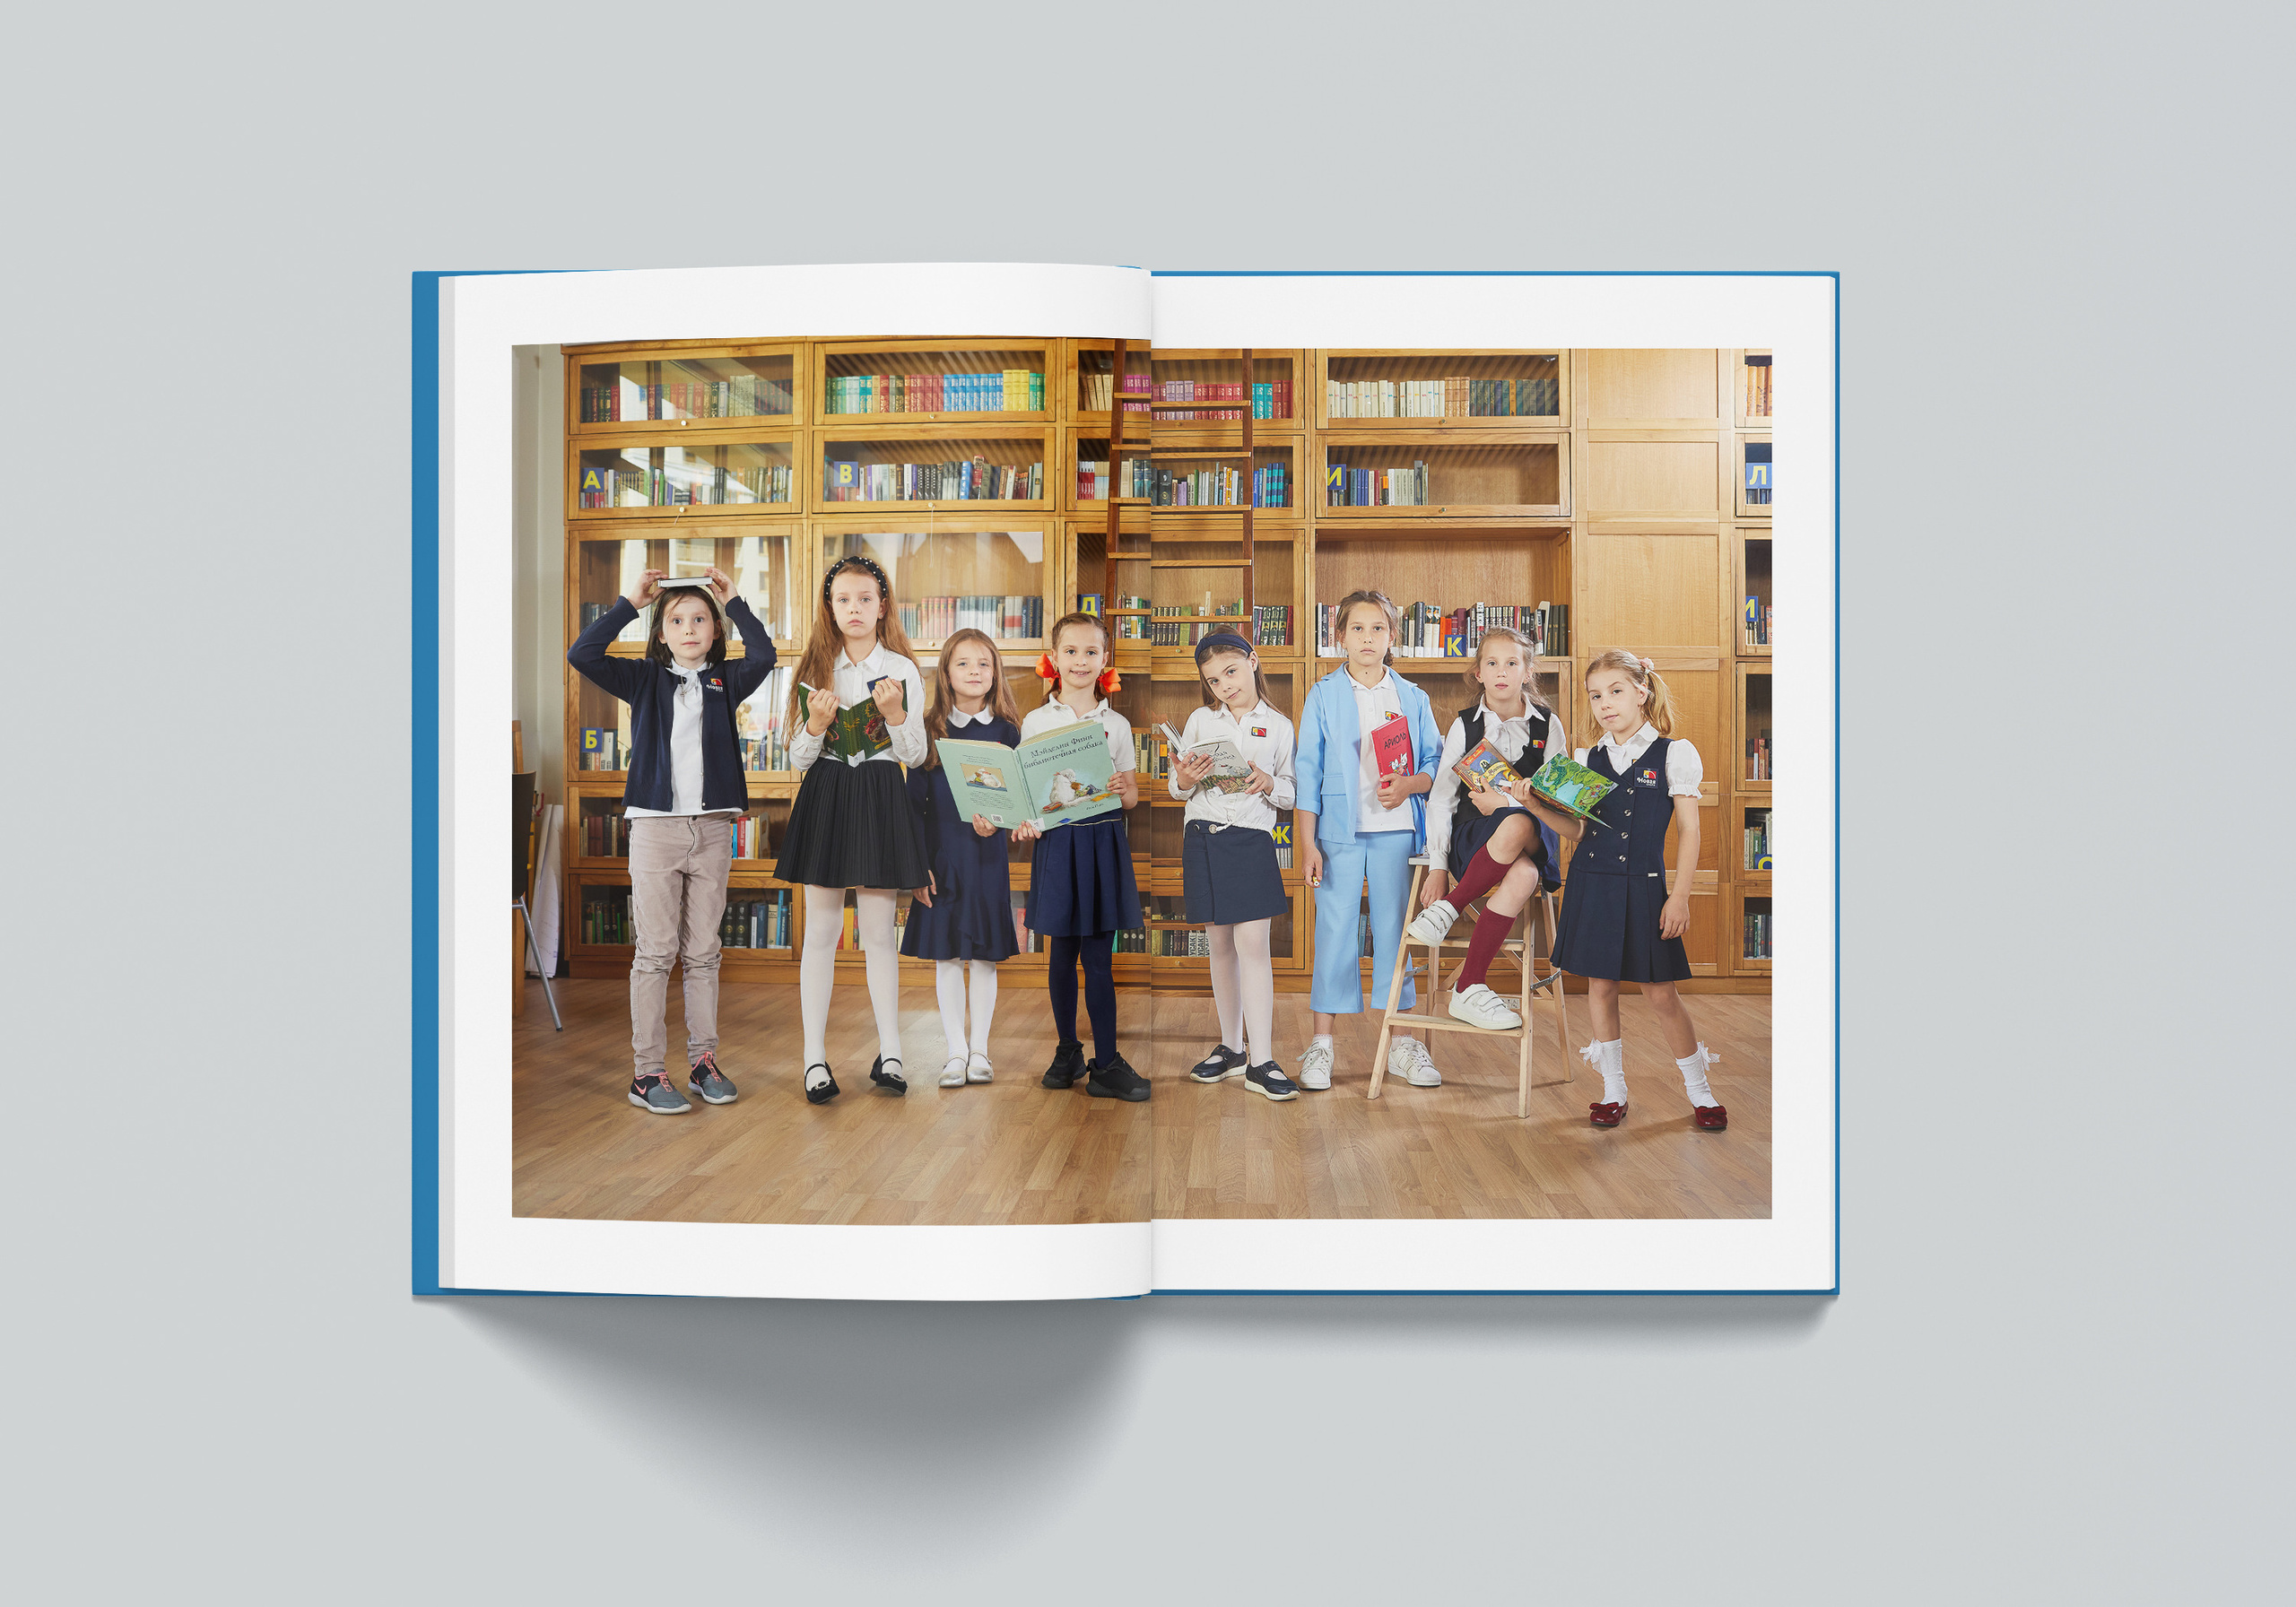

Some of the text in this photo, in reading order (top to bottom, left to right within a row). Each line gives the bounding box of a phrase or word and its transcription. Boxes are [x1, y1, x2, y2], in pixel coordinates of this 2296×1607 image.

[583, 470, 602, 490] А
[839, 465, 853, 483] В
[1326, 466, 1343, 486] И
[1749, 465, 1767, 485] Л
[1080, 596, 1099, 618] Д
[1447, 637, 1463, 656] К
[585, 729, 597, 749] Б
[1031, 734, 1093, 758] Мэйделин Финн
[1384, 732, 1407, 750] АРИОЛЬ
[1023, 741, 1103, 769] библиотечная собака
[1272, 825, 1292, 845] Ж
